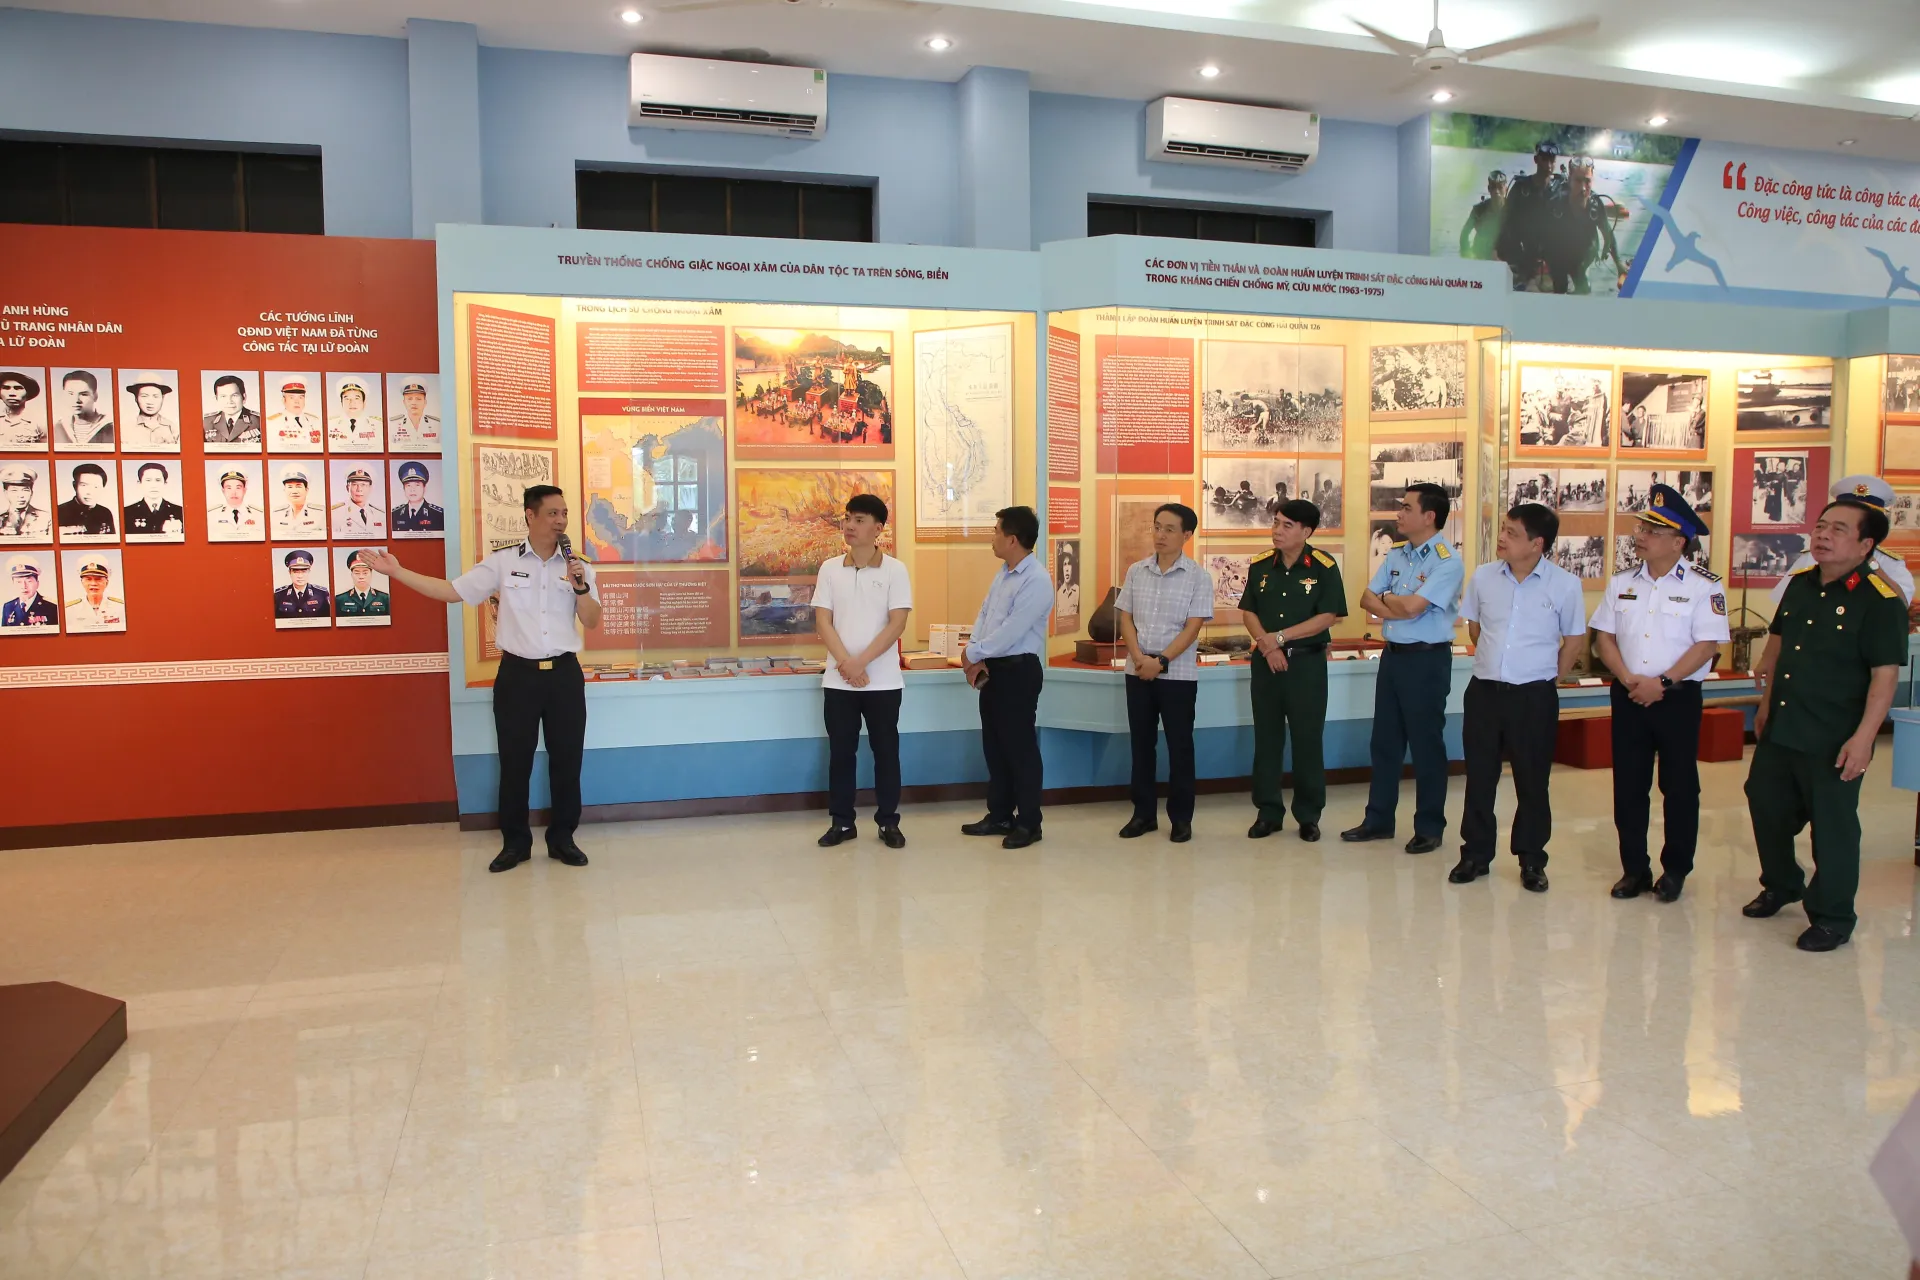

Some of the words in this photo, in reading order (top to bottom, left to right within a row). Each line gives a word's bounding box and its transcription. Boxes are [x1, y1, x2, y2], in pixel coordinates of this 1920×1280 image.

[1754, 175, 1780, 196] Đặc
[1782, 180, 1813, 201] công
[1816, 183, 1836, 199] tức
[1839, 185, 1851, 201] là
[1855, 188, 1884, 207] công
[1888, 191, 1906, 207] tác
[1737, 201, 1771, 223] Công
[1775, 205, 1802, 225] việc,
[1807, 209, 1837, 229] công
[1839, 212, 1859, 228] tác
[1862, 214, 1884, 230] của
[1886, 217, 1907, 232] các
[557, 252, 601, 266] TRUYỀN
[604, 254, 642, 267] THỐNG
[646, 256, 685, 269] CHỐNG
[689, 259, 713, 272] GIẶC
[716, 261, 750, 274] NGOẠI
[753, 261, 777, 273] XÂM
[780, 261, 800, 273] CỦA
[803, 263, 825, 275] DÂN
[828, 265, 849, 277] TỘC
[852, 267, 865, 277] TA
[867, 266, 892, 278] TRÊN
[895, 268, 925, 280] SÔNG,
[926, 267, 949, 280] BIỂN
[1145, 257, 1165, 269] CÁC
[1166, 260, 1188, 270] ĐƠN
[1190, 262, 1199, 272] VỊ
[1201, 259, 1220, 272] TIỀN
[1223, 262, 1246, 274] THÂN
[1248, 264, 1260, 275] VÀ
[1263, 265, 1288, 277] ĐOÀN
[1290, 266, 1315, 278] HUẤN
[1317, 269, 1343, 281] LUYỆN
[1345, 271, 1369, 282] TRINH
[1370, 272, 1385, 283] SÁT
[1387, 273, 1403, 286] ĐẶC
[1405, 274, 1428, 286] CÔNG
[1429, 275, 1443, 287] HẢI
[1445, 277, 1468, 289] QUÂN
[1470, 280, 1483, 289] 126
[1146, 273, 1178, 284] TRONG
[1180, 275, 1212, 286] KHÁNG
[1214, 276, 1240, 288] CHIẾN
[1242, 277, 1274, 290] CHỐNG
[1276, 280, 1290, 292] MỸ,
[1292, 281, 1310, 292] CỨU
[1312, 282, 1337, 293] NƯỚC
[1338, 285, 1385, 296] (1963-1975)
[2, 305, 30, 315] ANH
[33, 303, 69, 316] HÙNG
[259, 310, 282, 322] CÁC
[285, 311, 325, 323] TƯỚNG
[328, 311, 354, 323] LĨNH
[0, 318, 10, 331] Ũ
[13, 321, 56, 332] TRANG
[58, 320, 94, 333] NHÂN
[96, 321, 123, 333] DÂN
[1160, 314, 1179, 324] HUẤN
[1180, 317, 1203, 327] LUYỆN
[237, 326, 273, 337] QĐND
[275, 325, 298, 339] VIỆT
[301, 328, 327, 338] NAM
[330, 326, 346, 338] ĐÃ
[347, 327, 378, 339] TỪNG
[9, 335, 26, 347] LỮ
[28, 334, 66, 348] ĐOÀN
[242, 340, 275, 352] CÔNG
[278, 340, 298, 352] TÁC
[301, 343, 318, 355] TẠI
[320, 341, 335, 353] LỮ
[337, 341, 369, 353] ĐOÀN
[621, 405, 640, 413] VÙNG
[656, 405, 670, 414] VIỆT
[670, 405, 686, 413] NAM
